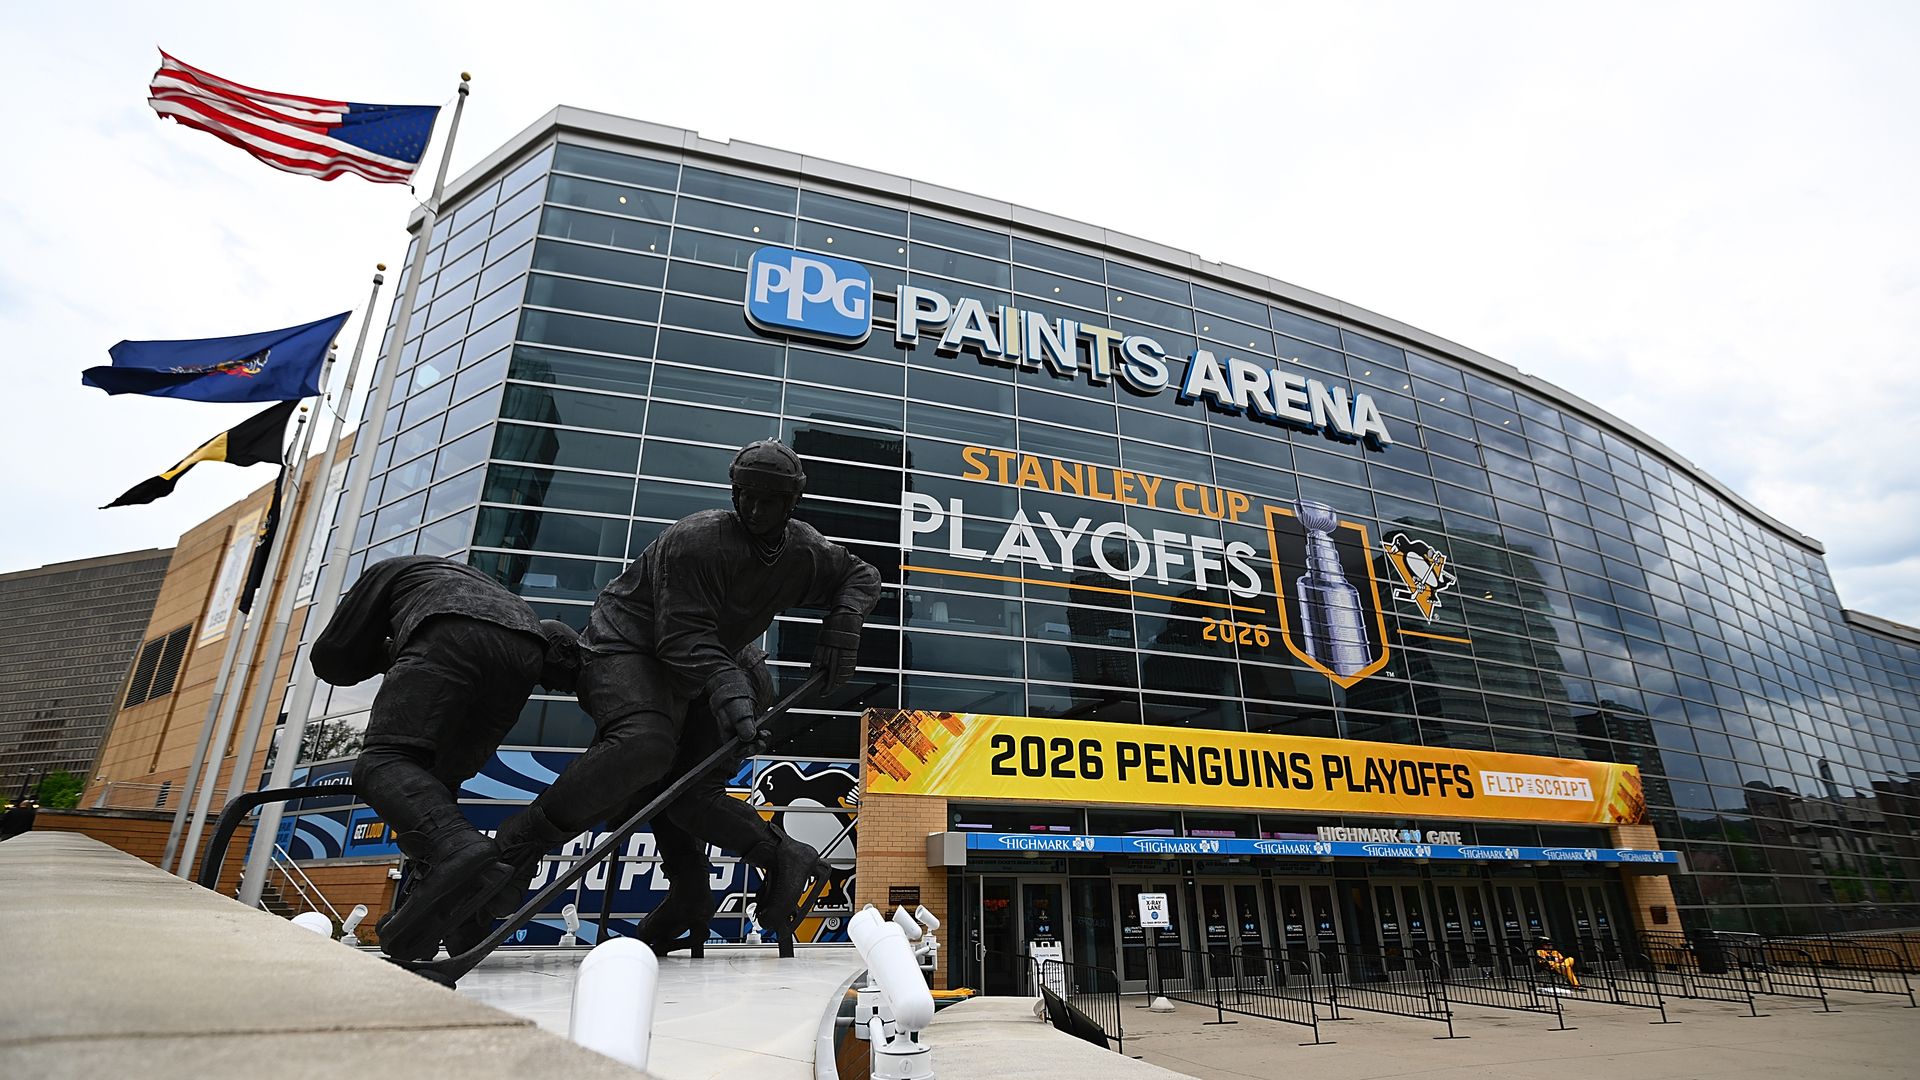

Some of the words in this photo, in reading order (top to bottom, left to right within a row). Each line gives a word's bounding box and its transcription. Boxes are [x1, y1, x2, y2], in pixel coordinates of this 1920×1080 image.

[755, 256, 866, 321] PPG
[897, 284, 1168, 393] PAINTS
[1182, 350, 1392, 446] ARENA
[962, 446, 1162, 508] STANLEY
[1175, 482, 1250, 522] CUP
[902, 491, 1263, 598] PLAYOFFS
[1203, 617, 1270, 647] 2026
[990, 734, 1104, 780] 2026
[1116, 741, 1314, 791] PENGUINS
[1322, 754, 1474, 799] PLAYOFFS
[1486, 775, 1524, 793] FLIP
[354, 824, 368, 839] GET
[365, 823, 384, 838] LOUD
[1317, 826, 1400, 843] HIGHMARK
[1426, 830, 1462, 845] GATE
[1005, 838, 1070, 850] HIGHMARK
[1140, 841, 1197, 853] HIGHMARK
[1260, 843, 1312, 855] HIGHMARK
[1368, 846, 1415, 857] HIGHMARK
[1463, 849, 1504, 860] HIGHMARK
[1546, 851, 1585, 861] HIGHMARK
